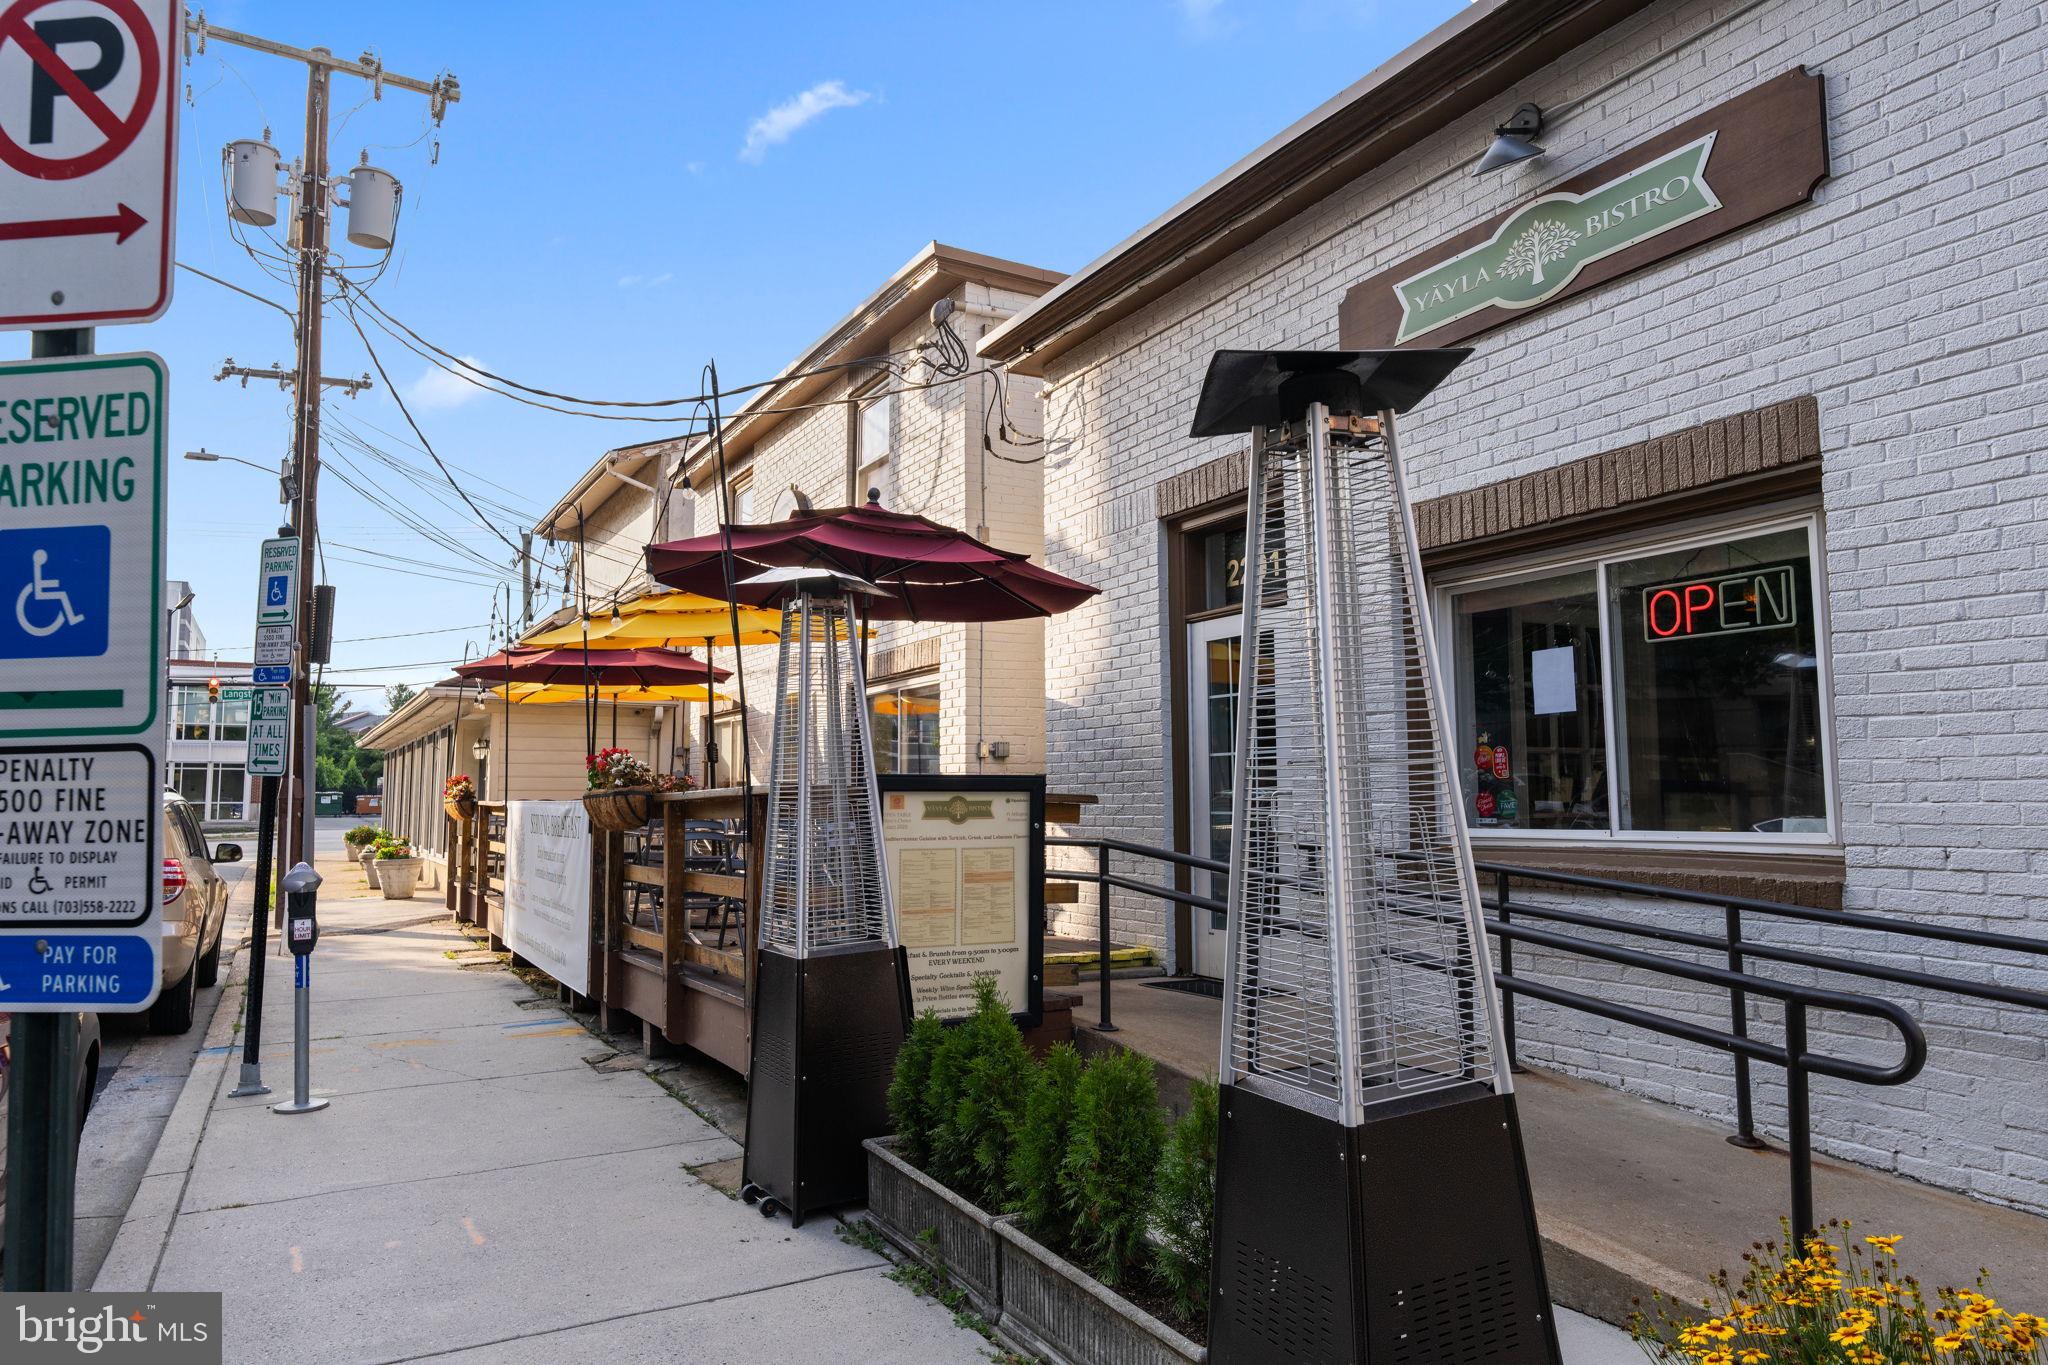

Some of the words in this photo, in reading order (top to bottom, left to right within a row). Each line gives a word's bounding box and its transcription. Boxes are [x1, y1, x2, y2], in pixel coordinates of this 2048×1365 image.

[1585, 175, 1690, 239] BISTRO
[264, 545, 297, 558] RESERVED
[264, 560, 294, 573] PARKING
[1650, 572, 1788, 637] OPEN
[252, 693, 263, 716] 15
[269, 691, 282, 704] MIN
[263, 705, 287, 718] PARKING
[252, 724, 264, 739] AT
[266, 724, 283, 739] ALL
[254, 743, 280, 757] TIMES
[56, 787, 107, 812] FINE
[84, 819, 145, 843] ZONE
[49, 851, 65, 865] TO
[70, 851, 118, 865] DISPLAY
[64, 875, 108, 889] PERMIT
[22, 901, 49, 914] CALL
[42, 945, 75, 965] PAY
[83, 945, 117, 965] FOR
[928, 950, 951, 958] Brunch
[928, 959, 951, 967] EVERY
[951, 957, 985, 966] WEEKEND
[42, 973, 120, 994] PARKING
[910, 974, 938, 982] Specialty
[916, 985, 939, 994] Weekly
[940, 984, 955, 992] Wine
